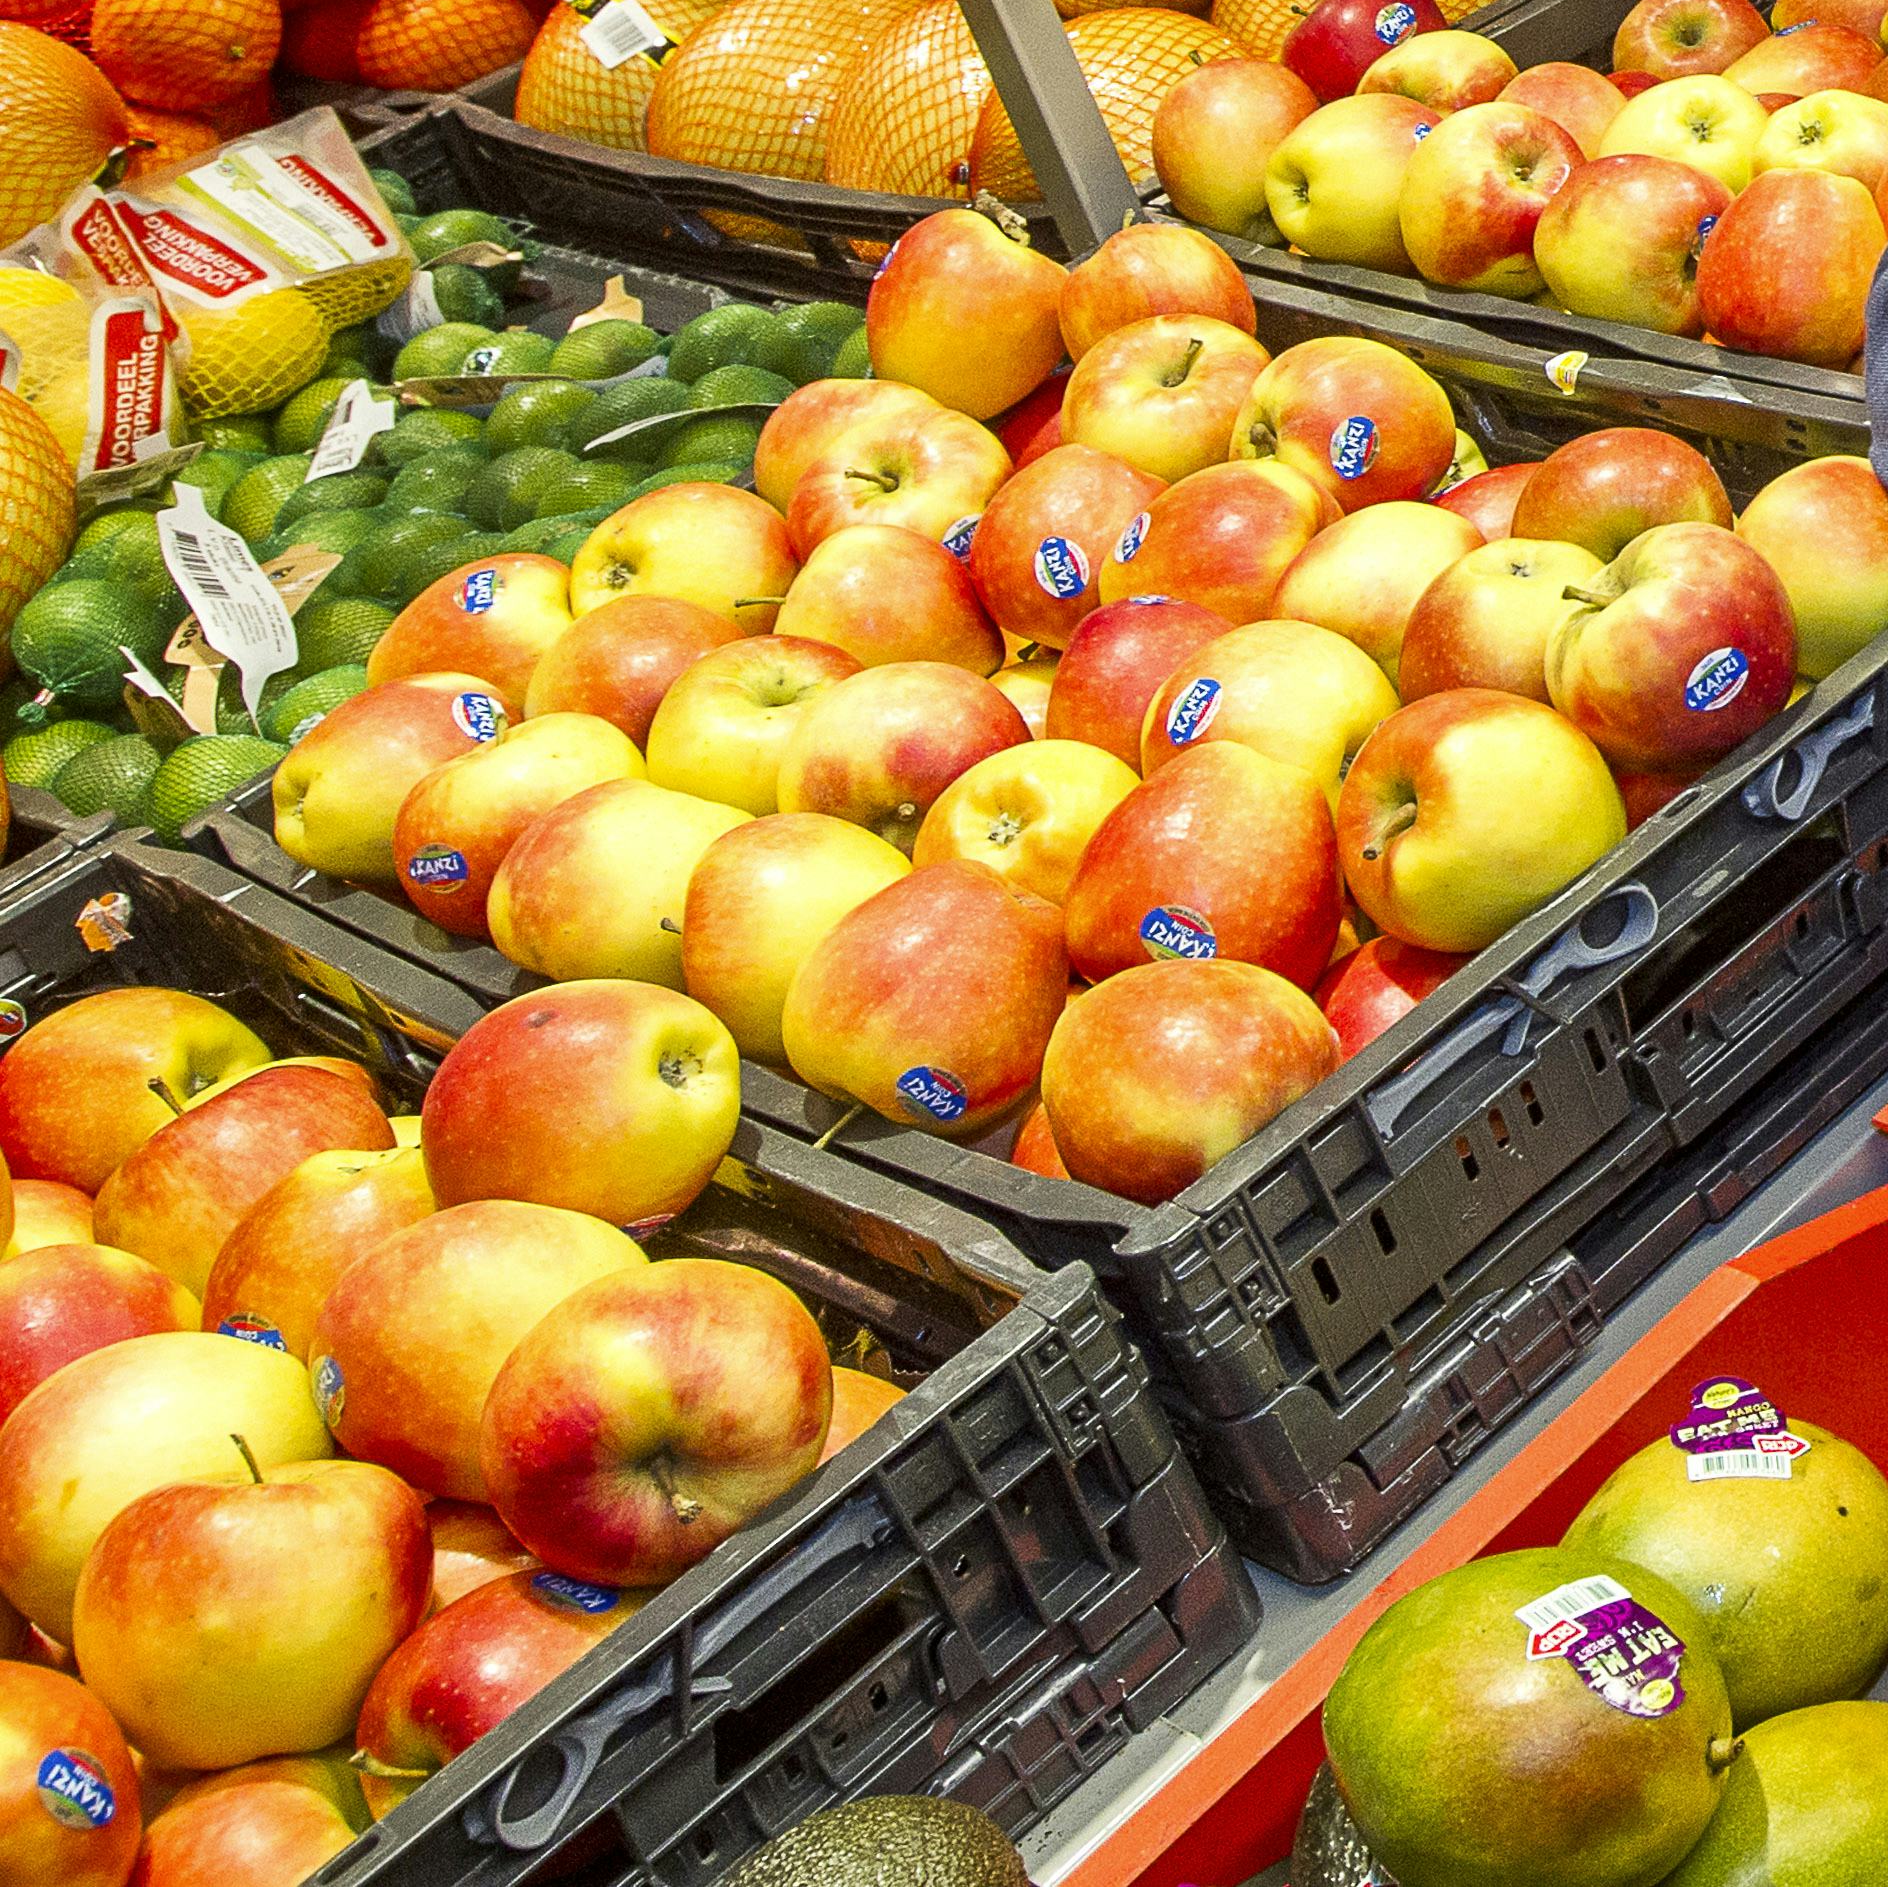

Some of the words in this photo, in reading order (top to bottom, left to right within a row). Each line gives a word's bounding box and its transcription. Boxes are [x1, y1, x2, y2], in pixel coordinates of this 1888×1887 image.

[143, 214, 253, 283] VERPAKKING
[144, 234, 235, 291] VOORDEEL
[110, 353, 138, 469] VOORDEEL
[1342, 423, 1364, 469] KANZI
[1043, 548, 1075, 593] KANZI
[1693, 655, 1739, 700] KANZI
[1174, 683, 1210, 733] KANZI
[416, 857, 458, 874] KANZI
[1149, 921, 1209, 959] KANZI
[908, 1077, 953, 1116] KANZI
[1677, 1419, 1732, 1443] EAT
[1736, 1408, 1777, 1428] ME
[1727, 1401, 1770, 1418] MANGO
[1627, 1627, 1678, 1665] EAT
[47, 1764, 114, 1821] KANZI
